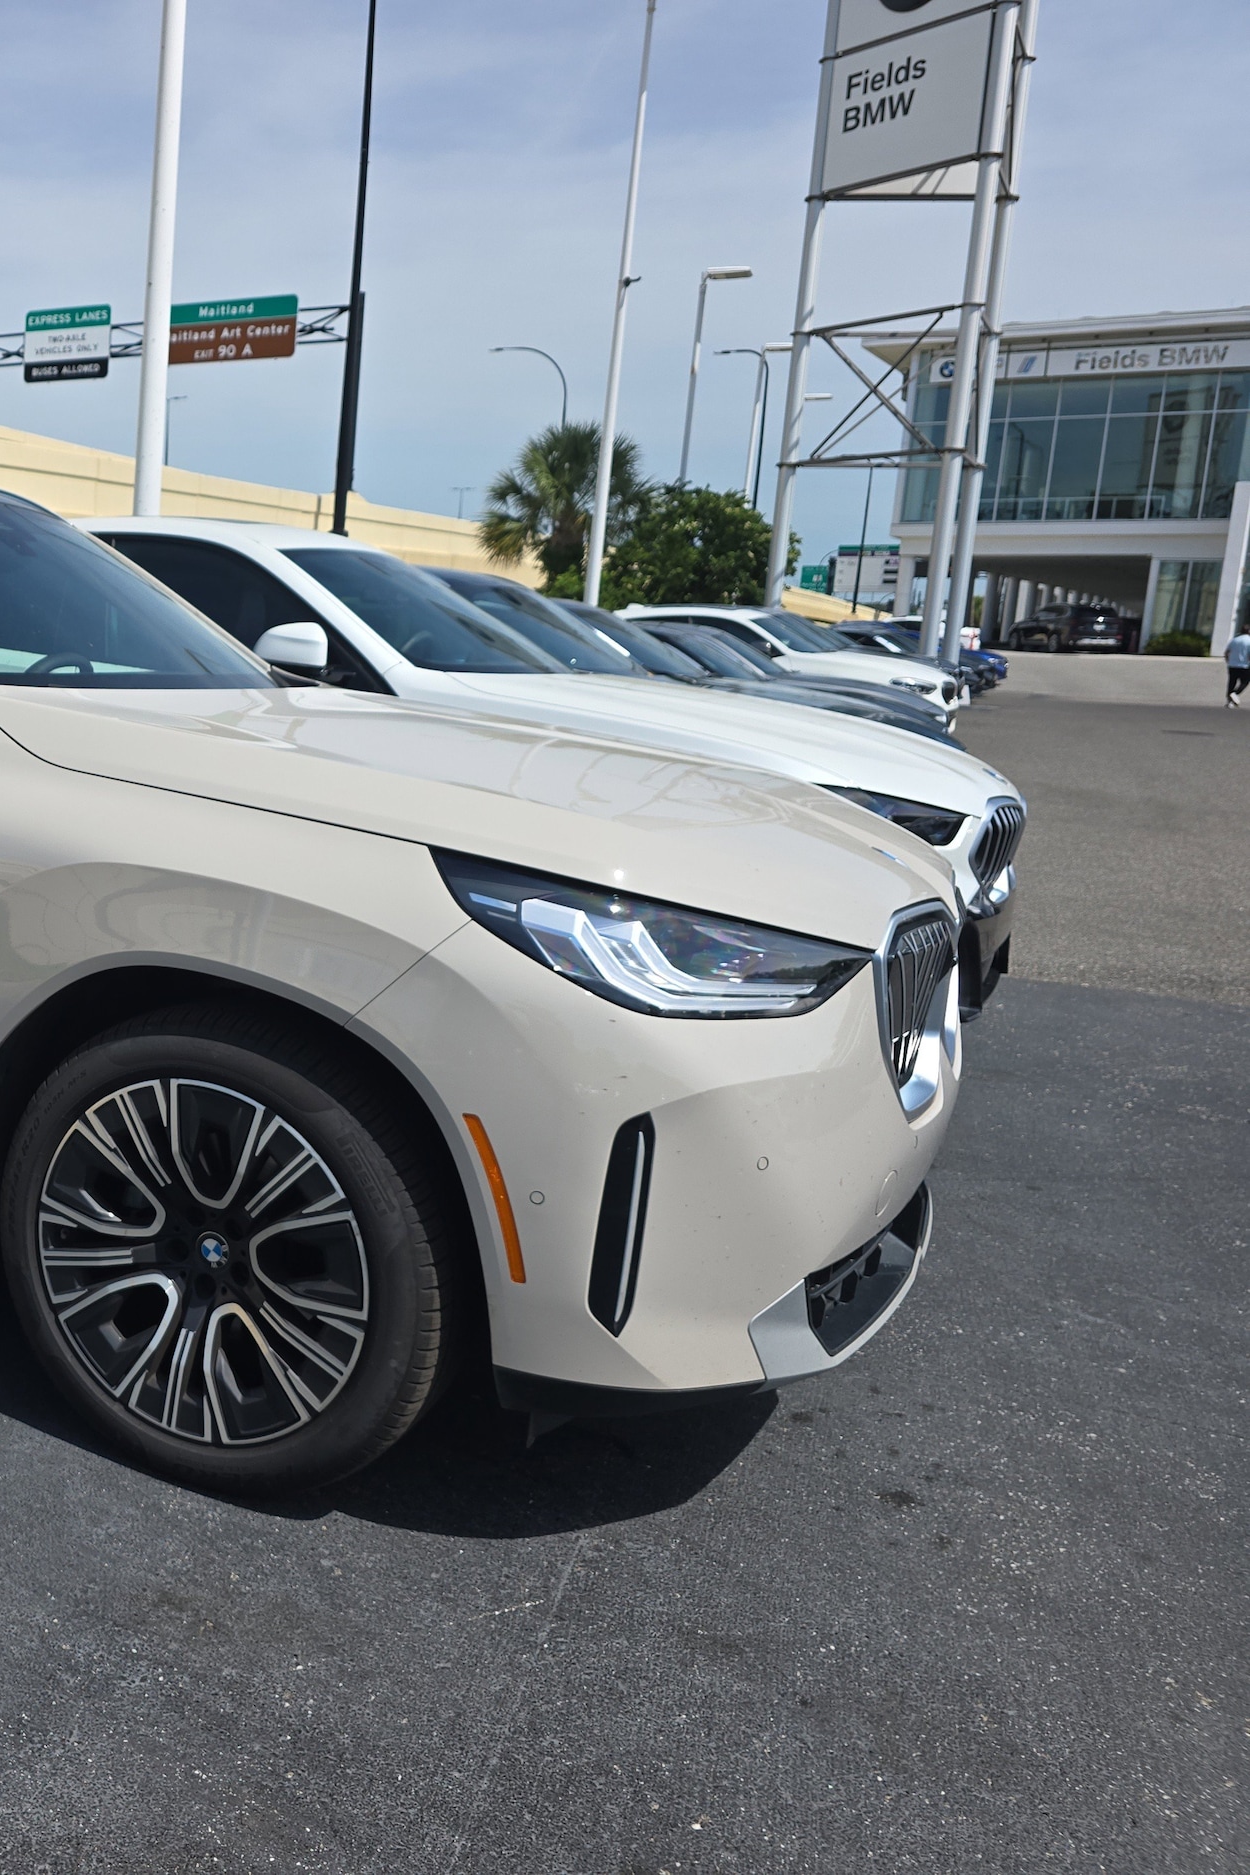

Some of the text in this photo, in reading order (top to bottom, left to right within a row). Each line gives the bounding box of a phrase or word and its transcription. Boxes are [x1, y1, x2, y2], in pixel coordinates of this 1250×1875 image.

[846, 56, 927, 100] Fields
[842, 88, 916, 134] BMW
[28, 309, 108, 326] EXPRESS LANES
[198, 302, 254, 317] Maitland
[170, 324, 290, 343] aitland Art Center
[77, 343, 98, 353] ONLY
[217, 344, 237, 357] 90
[241, 342, 253, 356] A
[1075, 345, 1229, 370] Fields BMW
[31, 363, 101, 377] BUSES ALLOWED
[335, 1132, 397, 1219] PIRELLI
